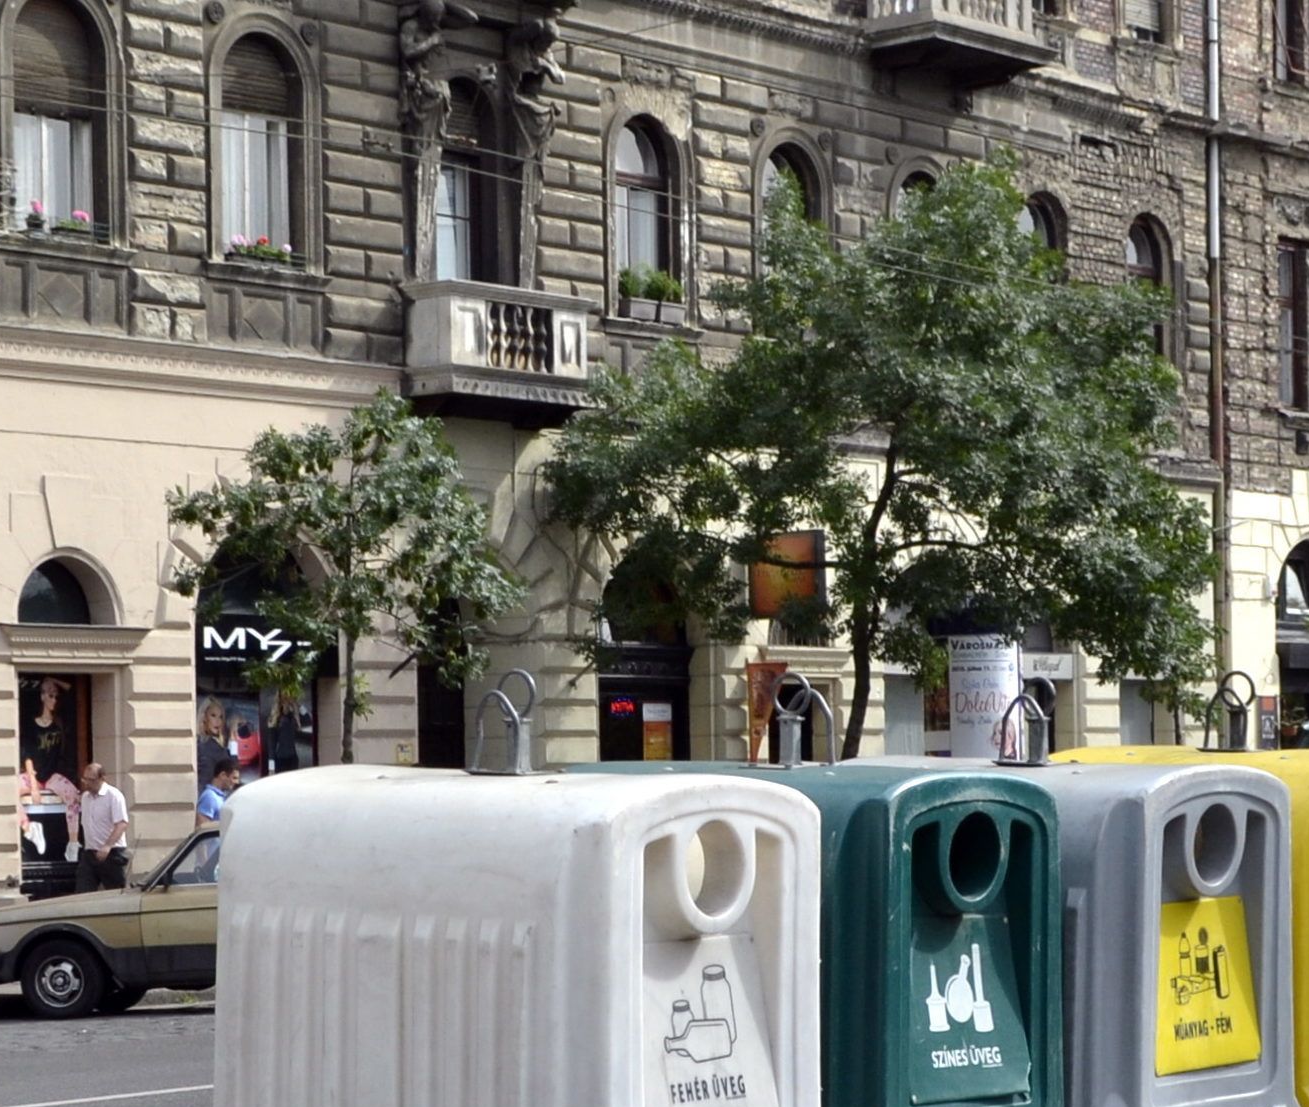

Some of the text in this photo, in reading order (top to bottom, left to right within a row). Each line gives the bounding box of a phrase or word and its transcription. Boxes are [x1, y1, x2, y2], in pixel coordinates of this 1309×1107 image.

[1216, 1011, 1232, 1035] FÉM
[931, 1045, 1002, 1069] SZÍNES ÜVEG
[670, 1074, 746, 1104] FEHÉR ÜVEG
